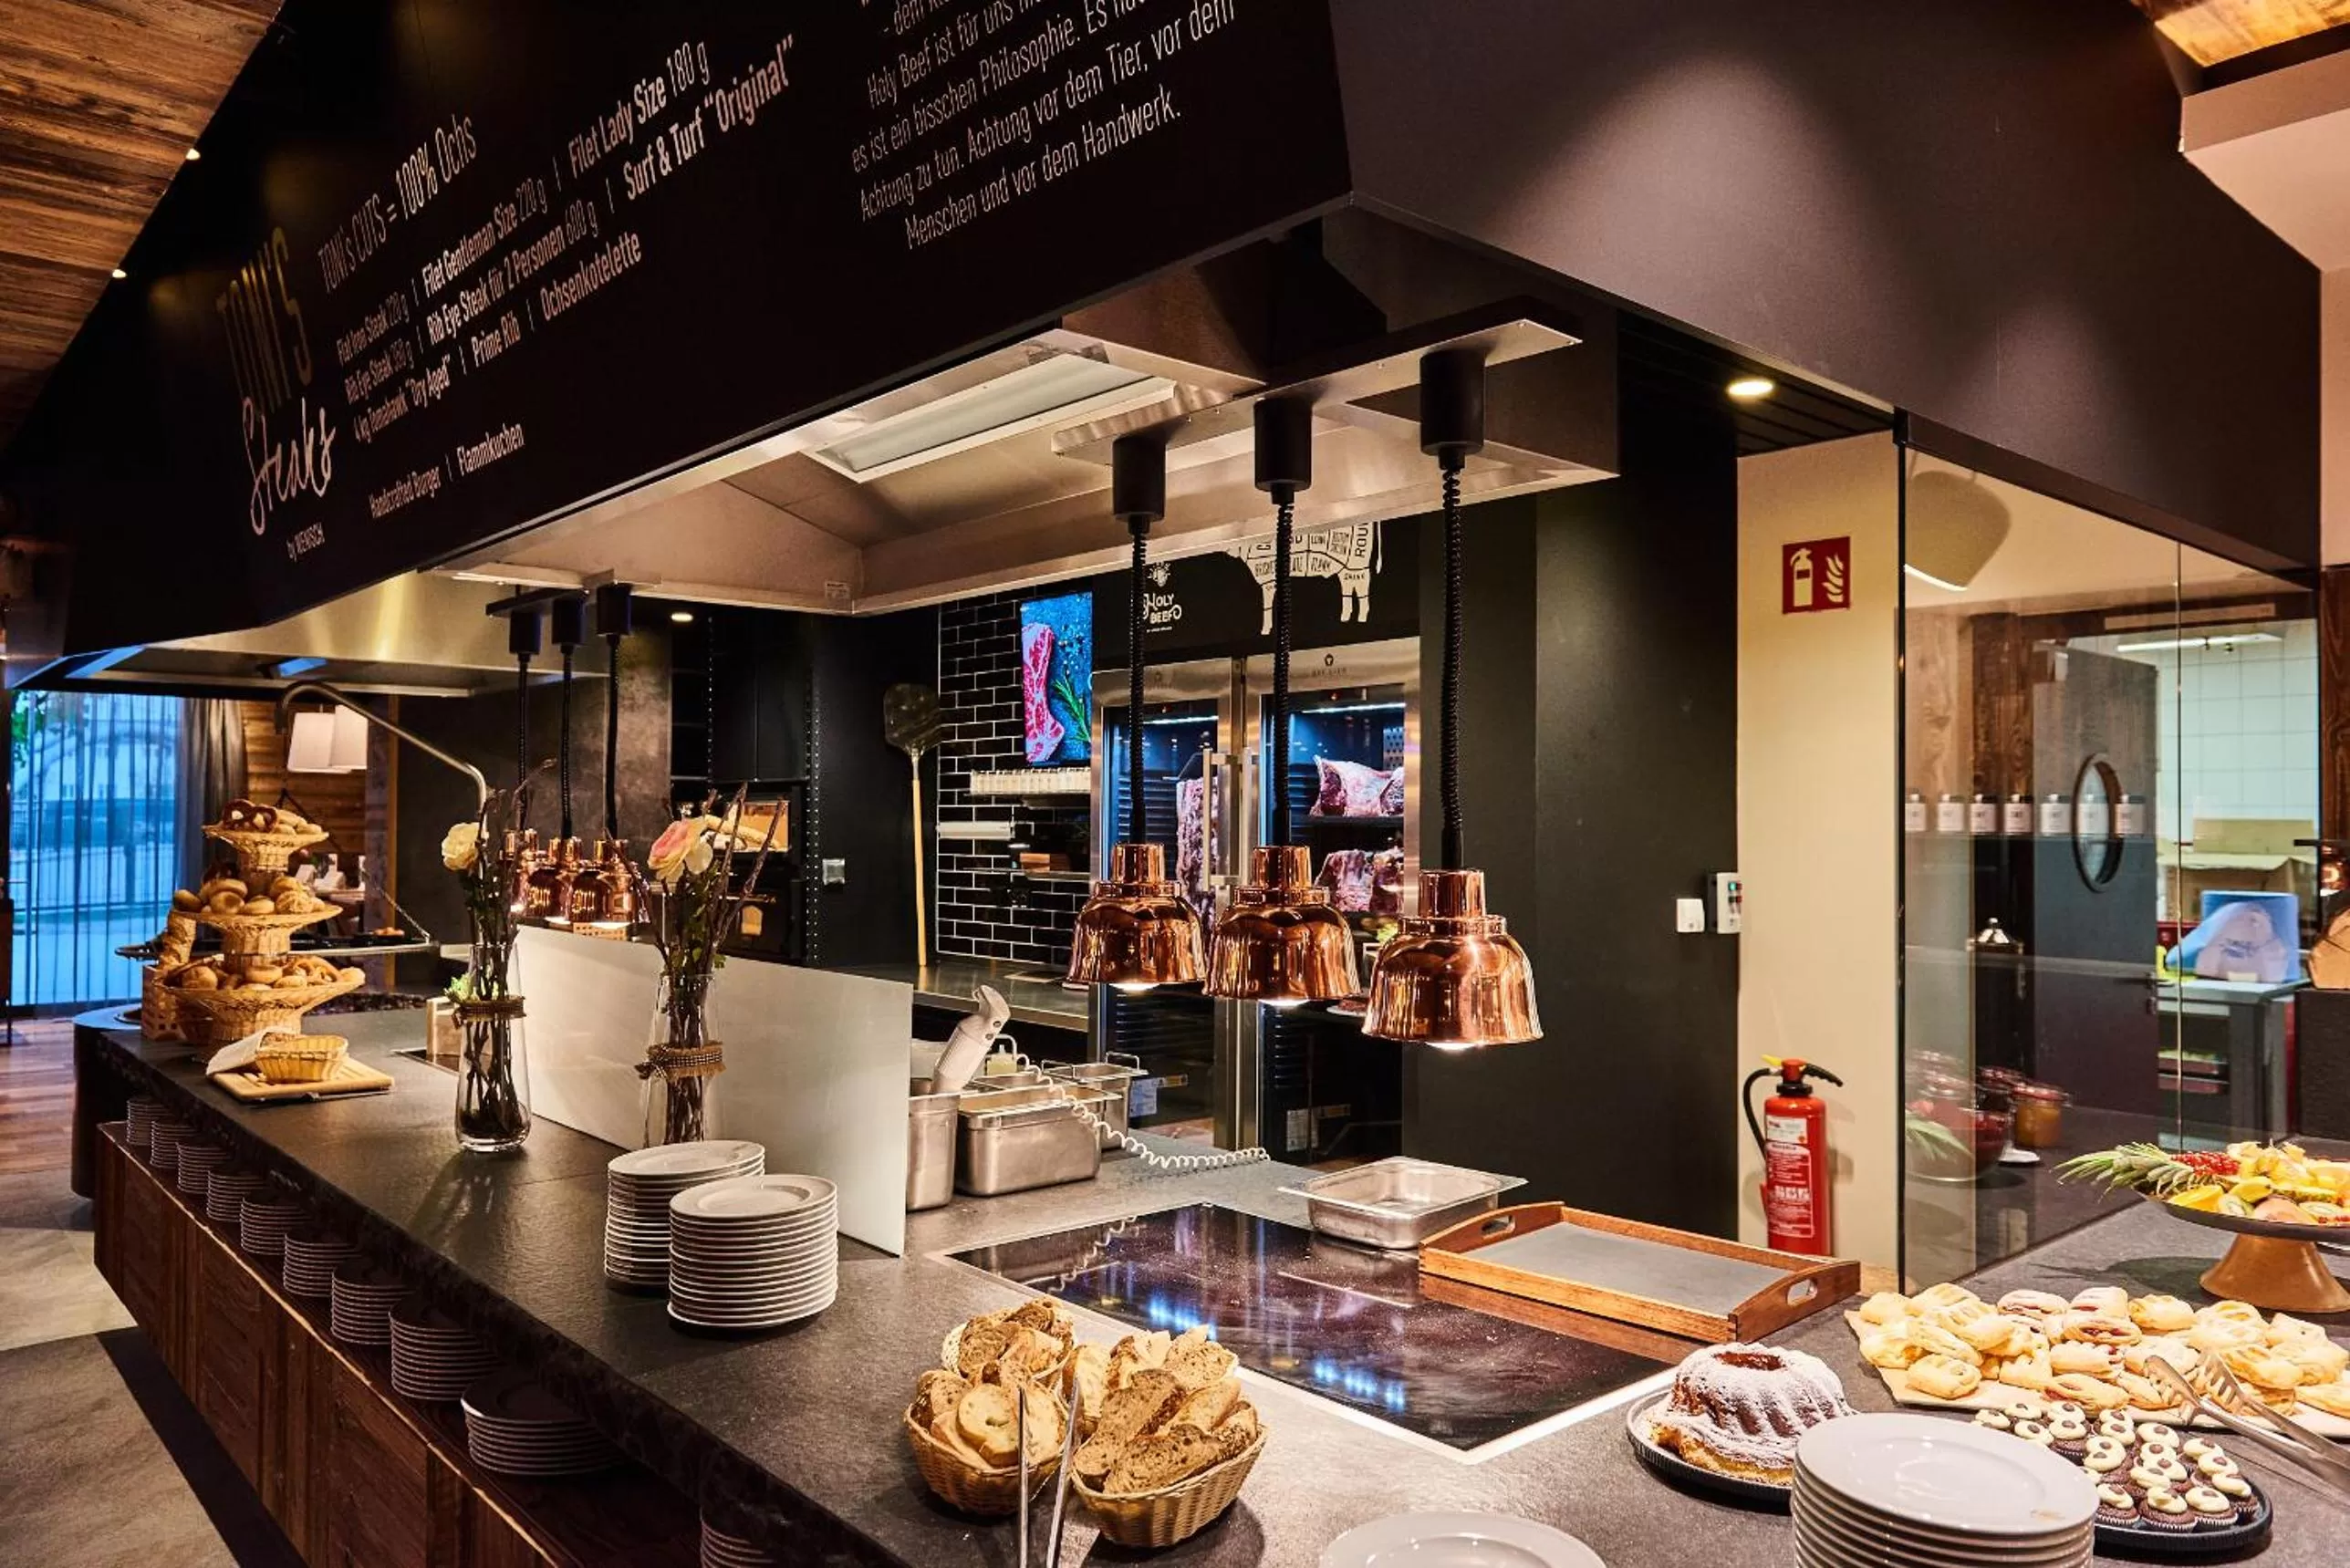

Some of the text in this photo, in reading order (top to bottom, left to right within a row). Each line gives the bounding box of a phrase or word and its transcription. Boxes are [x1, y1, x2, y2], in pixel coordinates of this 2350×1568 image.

[852, 143, 868, 172] es
[869, 127, 889, 163] ist
[890, 113, 912, 151] ein
[913, 78, 977, 136] bisschen
[979, 13, 1082, 96] Philosophie.
[1085, 0, 1107, 35] Es
[860, 171, 914, 223] Achtung
[916, 162, 933, 191] zu
[934, 145, 965, 181] tun.
[967, 105, 1031, 164] Achtung
[1034, 87, 1060, 125] vor
[1065, 68, 1104, 109] dem
[1106, 41, 1149, 86] Tier,
[1150, 17, 1182, 61] vor
[1189, 0, 1234, 41] dem
[868, 0, 1014, 109] Holy Beef ist für uns
[351, 192, 387, 263] CUTS
[395, 141, 438, 221] 100%
[434, 113, 477, 183] Ochs
[365, 304, 390, 344] Steak
[421, 256, 447, 298] Filet
[442, 222, 496, 278] Gentleman
[494, 202, 518, 241] Size
[537, 178, 548, 214] g
[568, 125, 601, 180] Filet
[598, 99, 634, 153] Lady
[634, 75, 667, 125] Size
[666, 41, 695, 98] 180
[696, 41, 711, 86] g
[905, 83, 1181, 250] Menschen und vor dem Handwerk.
[369, 350, 394, 388] Steak
[427, 310, 445, 347] Rib
[442, 303, 463, 339] Eye
[460, 276, 492, 322] Steak
[488, 266, 505, 303] für
[504, 255, 515, 291] 2
[512, 224, 567, 285] Personen
[588, 201, 599, 238] g
[623, 143, 657, 201] Surf
[656, 135, 673, 177] &
[668, 105, 705, 165] Turf
[471, 329, 503, 368] Prime
[501, 309, 522, 349] Rib
[539, 230, 641, 322] Ochsenkotelette
[456, 422, 526, 477] Flammkuchen
[1142, 592, 1175, 620] HOLY
[1149, 604, 1182, 625] BEEF
